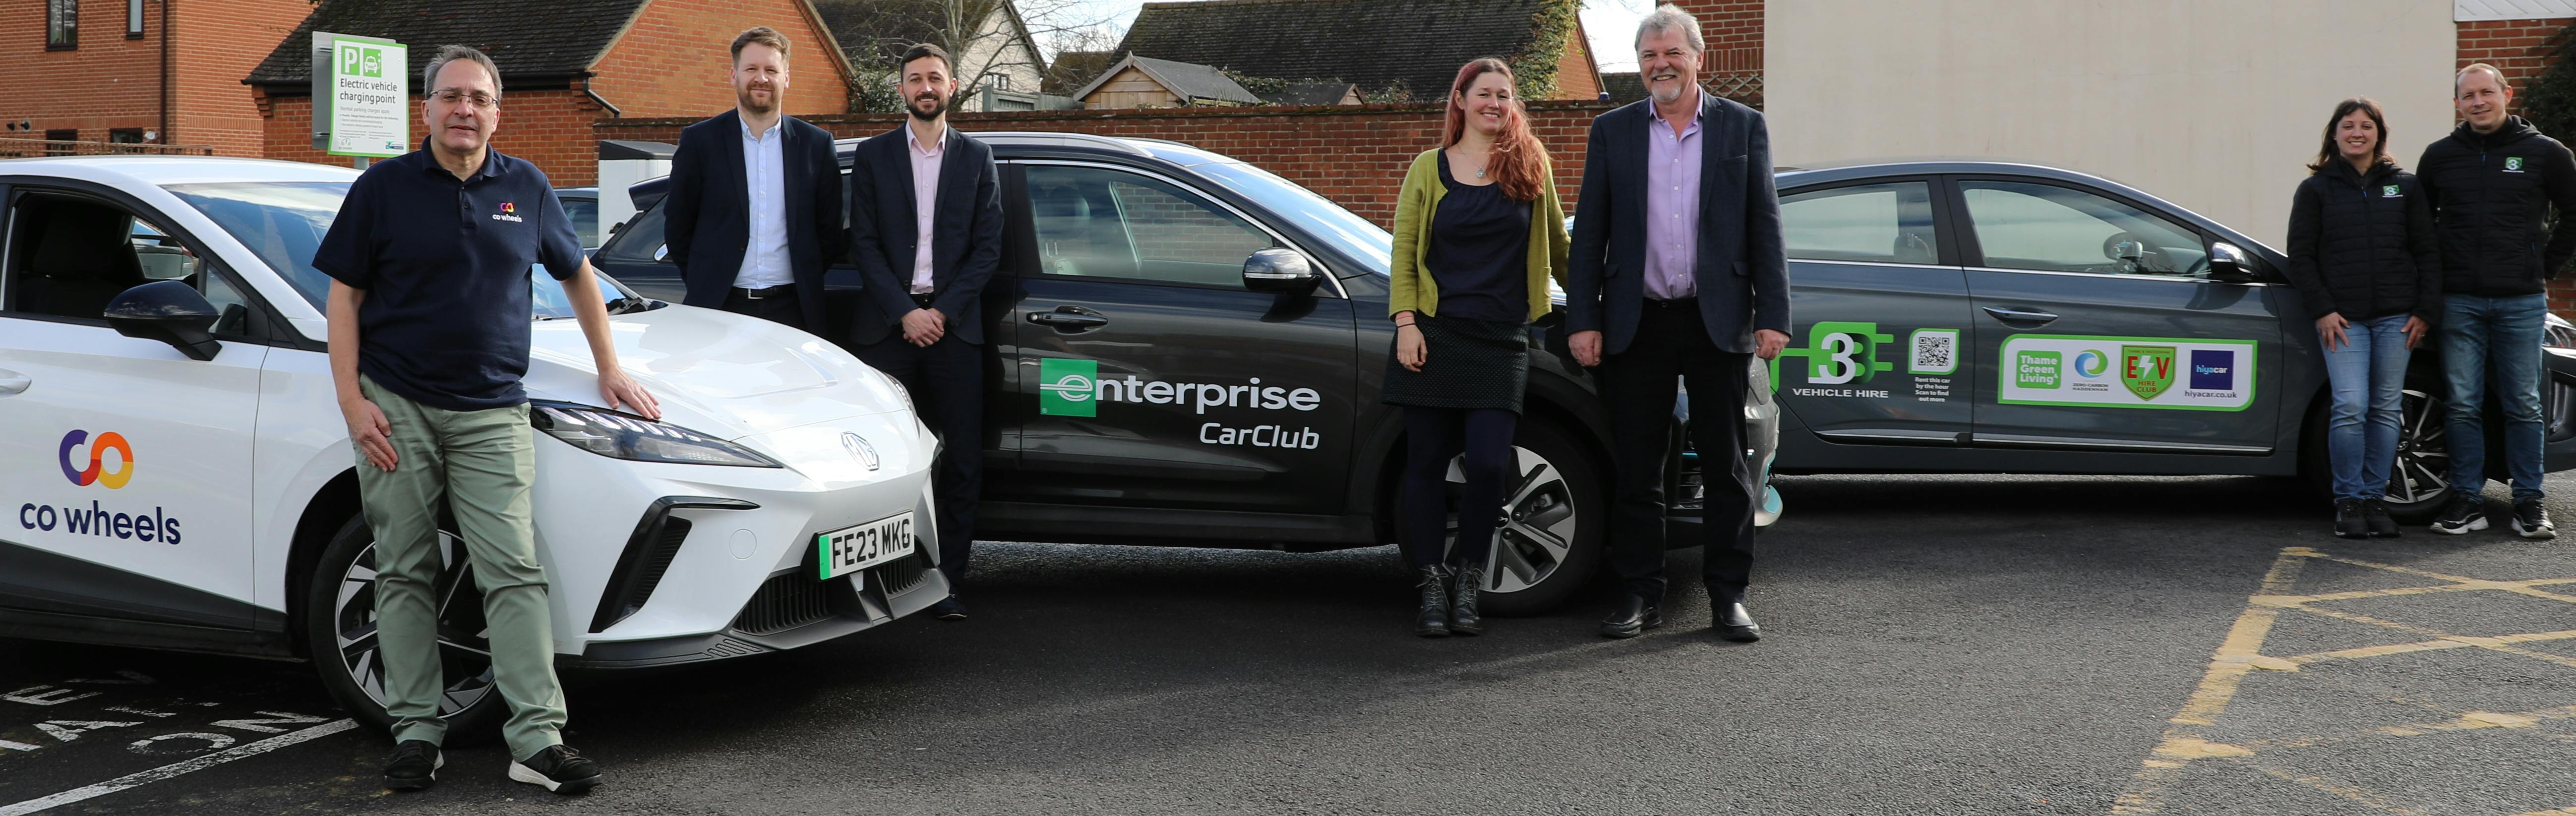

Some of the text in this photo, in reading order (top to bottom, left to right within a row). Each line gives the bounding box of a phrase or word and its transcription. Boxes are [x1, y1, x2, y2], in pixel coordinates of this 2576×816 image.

[345, 48, 358, 73] P
[340, 78, 397, 92] Electric vehicle
[340, 91, 396, 105] charging point
[2508, 159, 2517, 170] 3
[501, 214, 522, 222] wheels
[2020, 355, 2058, 365] Thame
[2020, 364, 2055, 374] Green
[2196, 365, 2228, 375] hiyacar
[2020, 373, 2054, 385] Living
[1040, 374, 1320, 414] enterprise
[1792, 388, 1889, 398] VEHICLE HIRE
[2185, 390, 2237, 399] hiyacar.co.uk
[1199, 422, 1319, 449] CarClub
[20, 500, 181, 545] co wheels
[832, 518, 910, 570] FE23 MKG
